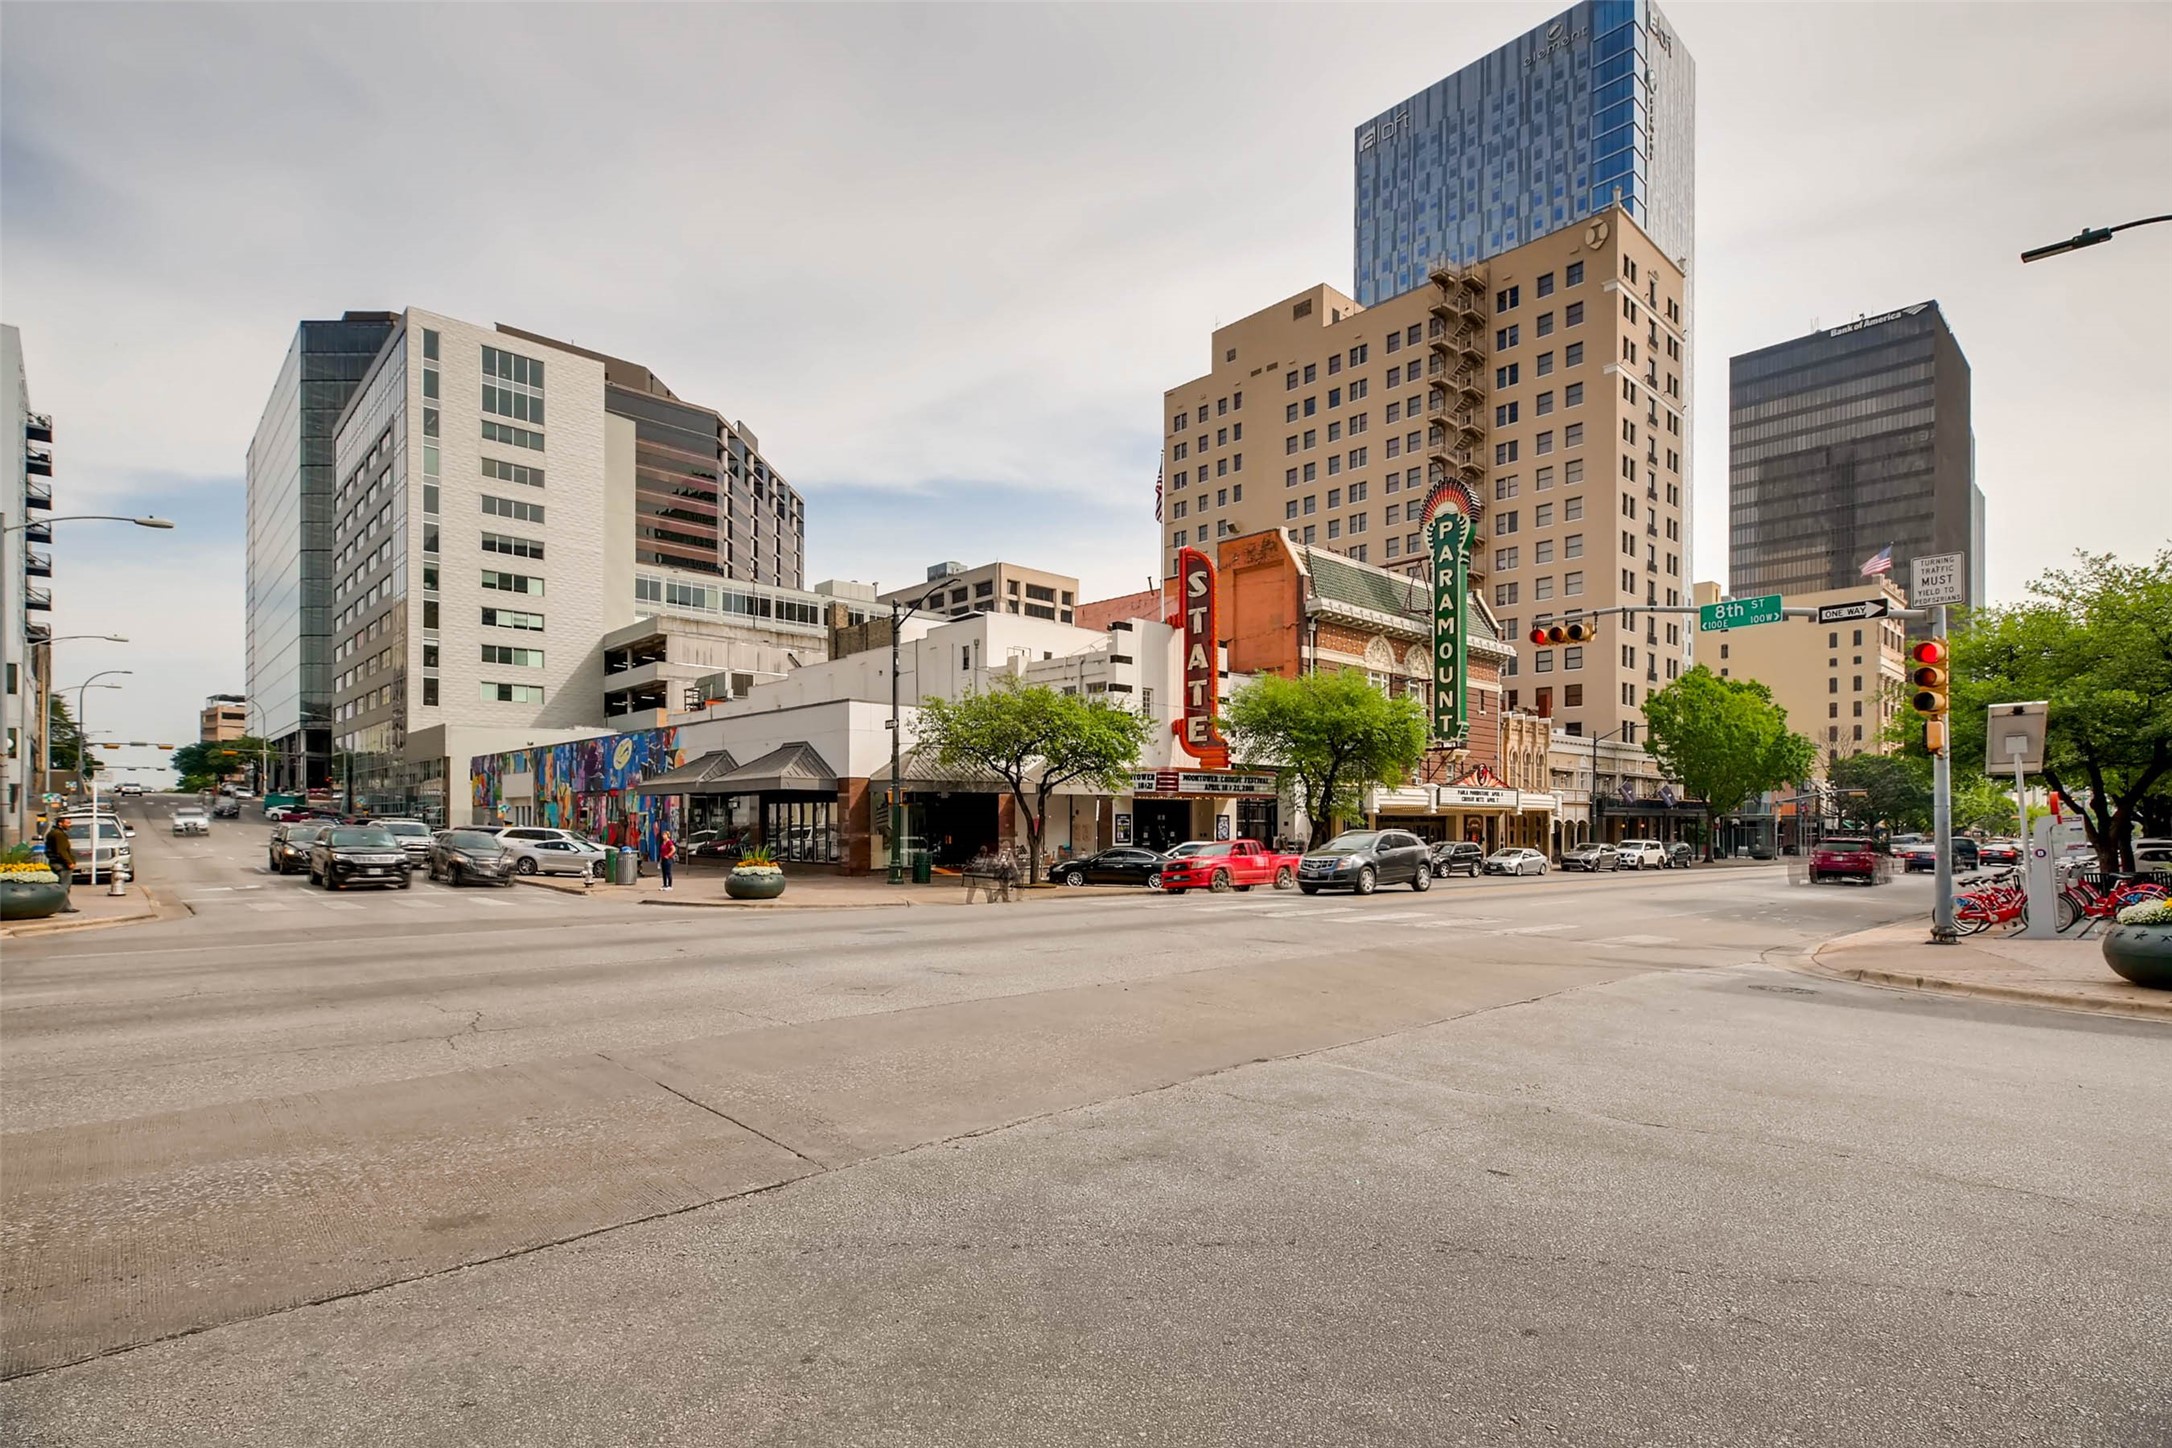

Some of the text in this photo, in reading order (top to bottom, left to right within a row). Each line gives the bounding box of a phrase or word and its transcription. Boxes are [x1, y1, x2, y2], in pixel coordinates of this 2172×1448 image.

[1523, 26, 1588, 67] element
[1359, 109, 1409, 153] aloft
[1830, 312, 1902, 337] Bank of America
[1920, 556, 1955, 567] TURNING
[1921, 564, 1954, 575] TRAFFIC
[1921, 574, 1953, 587] MUST
[1918, 588, 1940, 597] YIELD
[1914, 594, 1961, 605] PEDESTRIANS
[1715, 599, 1765, 619] 8th ST
[1825, 606, 1866, 618] ONE WAY
[1438, 520, 1455, 733] PARAMOUNT
[1708, 619, 1729, 629] 100E
[1187, 570, 1209, 742] STATE
